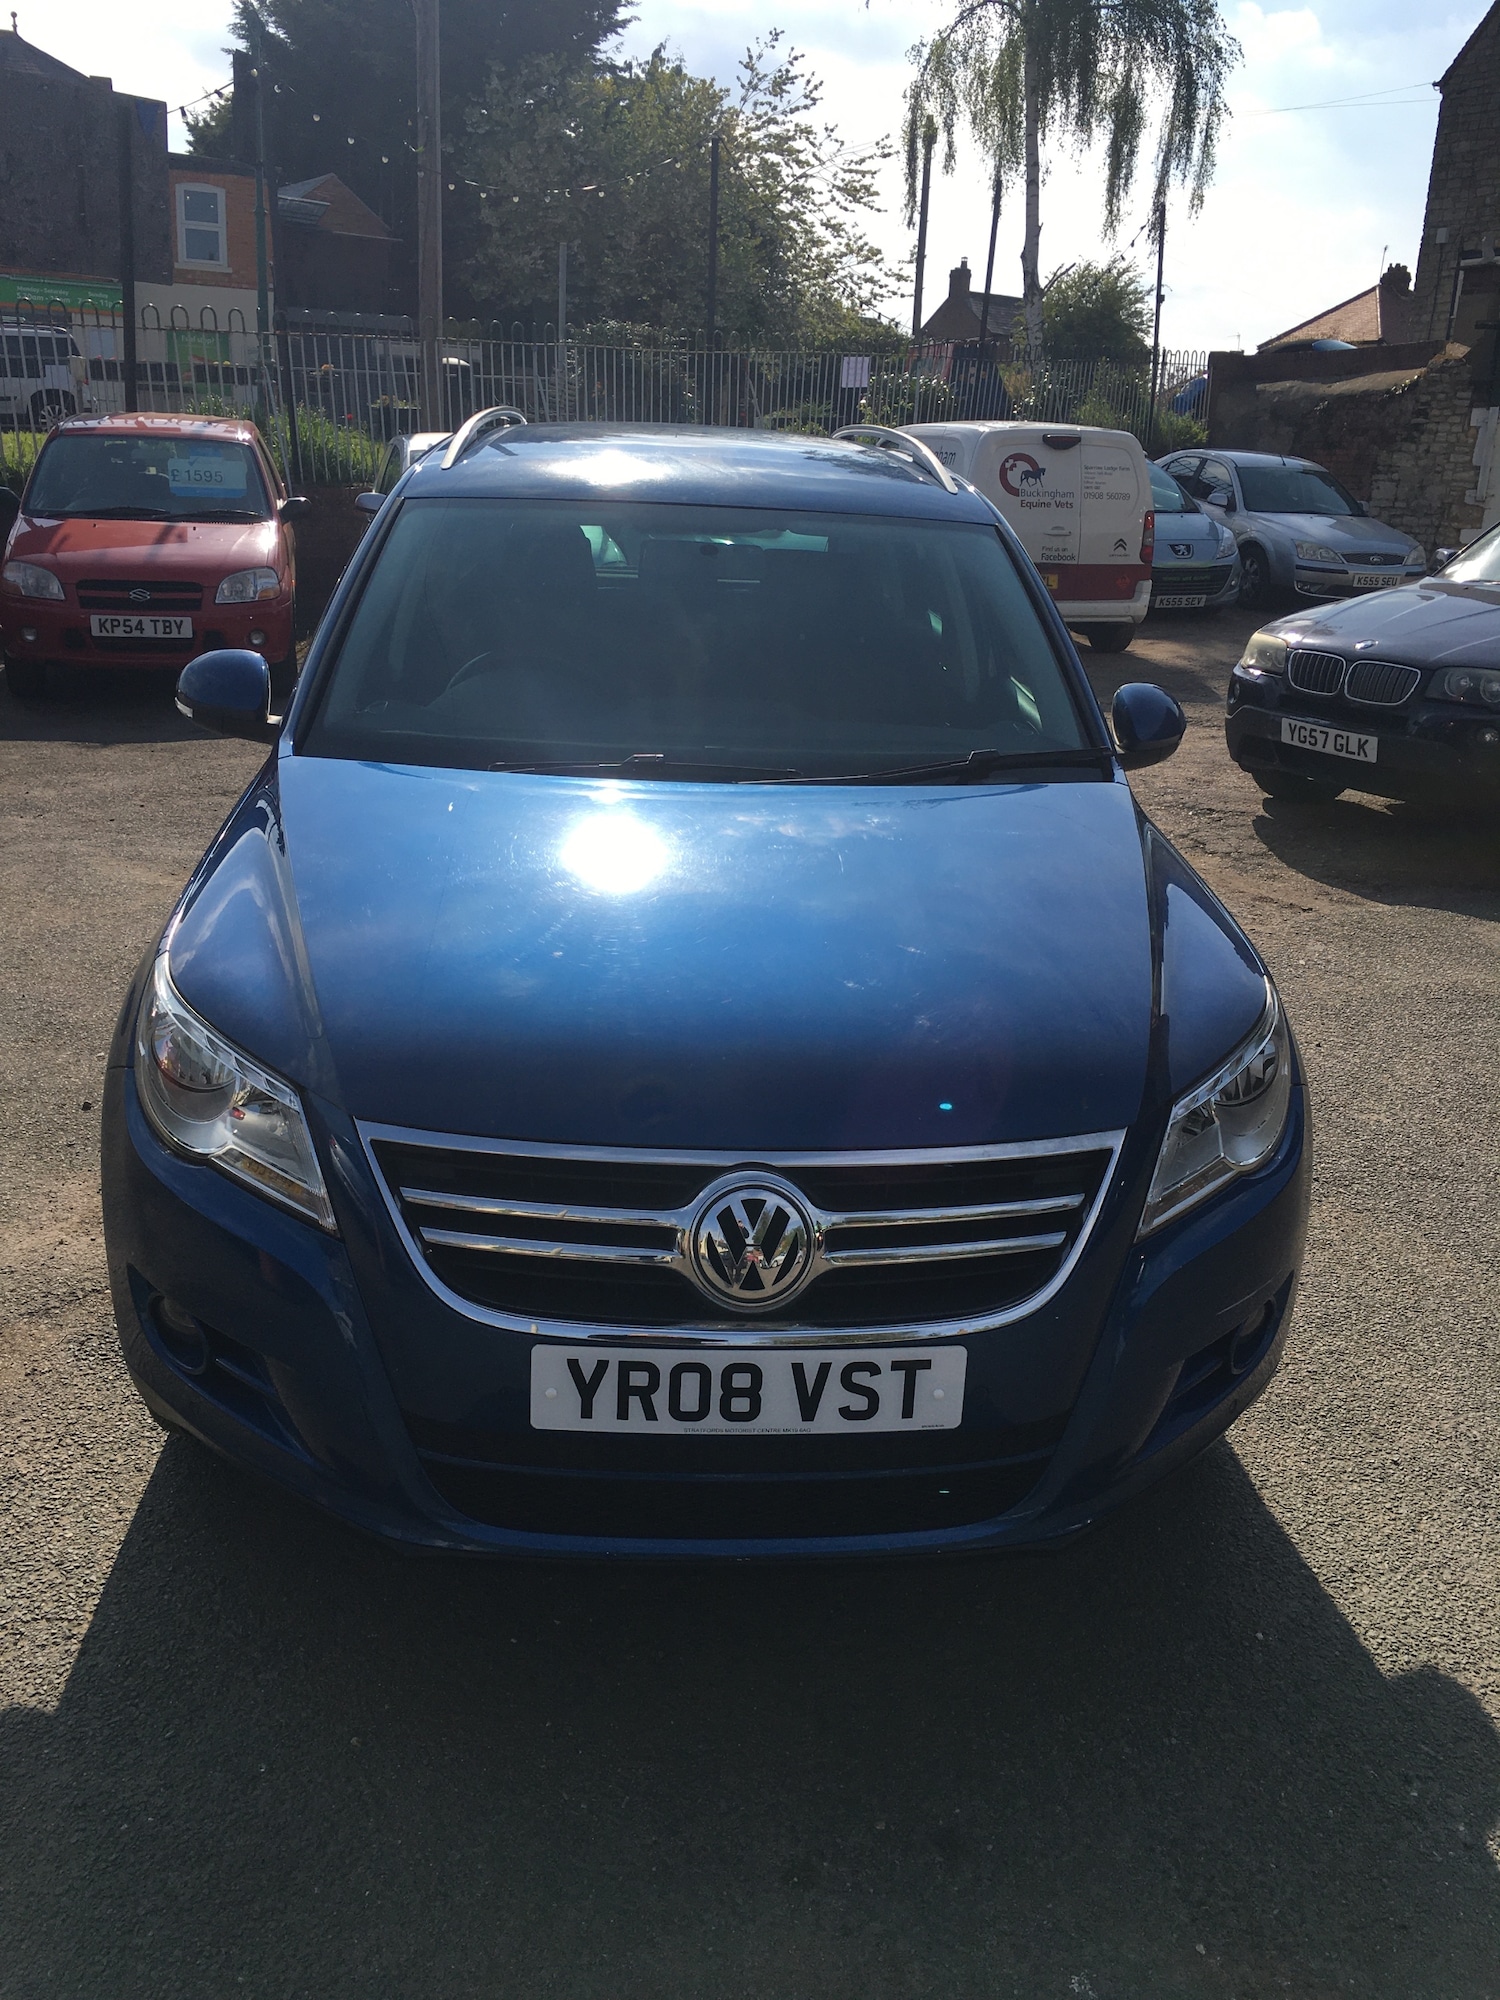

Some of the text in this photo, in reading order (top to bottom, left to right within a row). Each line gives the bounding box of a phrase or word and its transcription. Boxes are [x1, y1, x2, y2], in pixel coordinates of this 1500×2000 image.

[1021, 488, 1075, 500] Buckingham
[1083, 491, 1104, 500] 01908
[1021, 499, 1074, 510] Equine Vets
[1041, 553, 1076, 561] Facebook
[98, 618, 184, 635] KP54 TBY
[1288, 722, 1369, 758] YG57 GLK
[566, 1358, 932, 1422] YR08 VST
